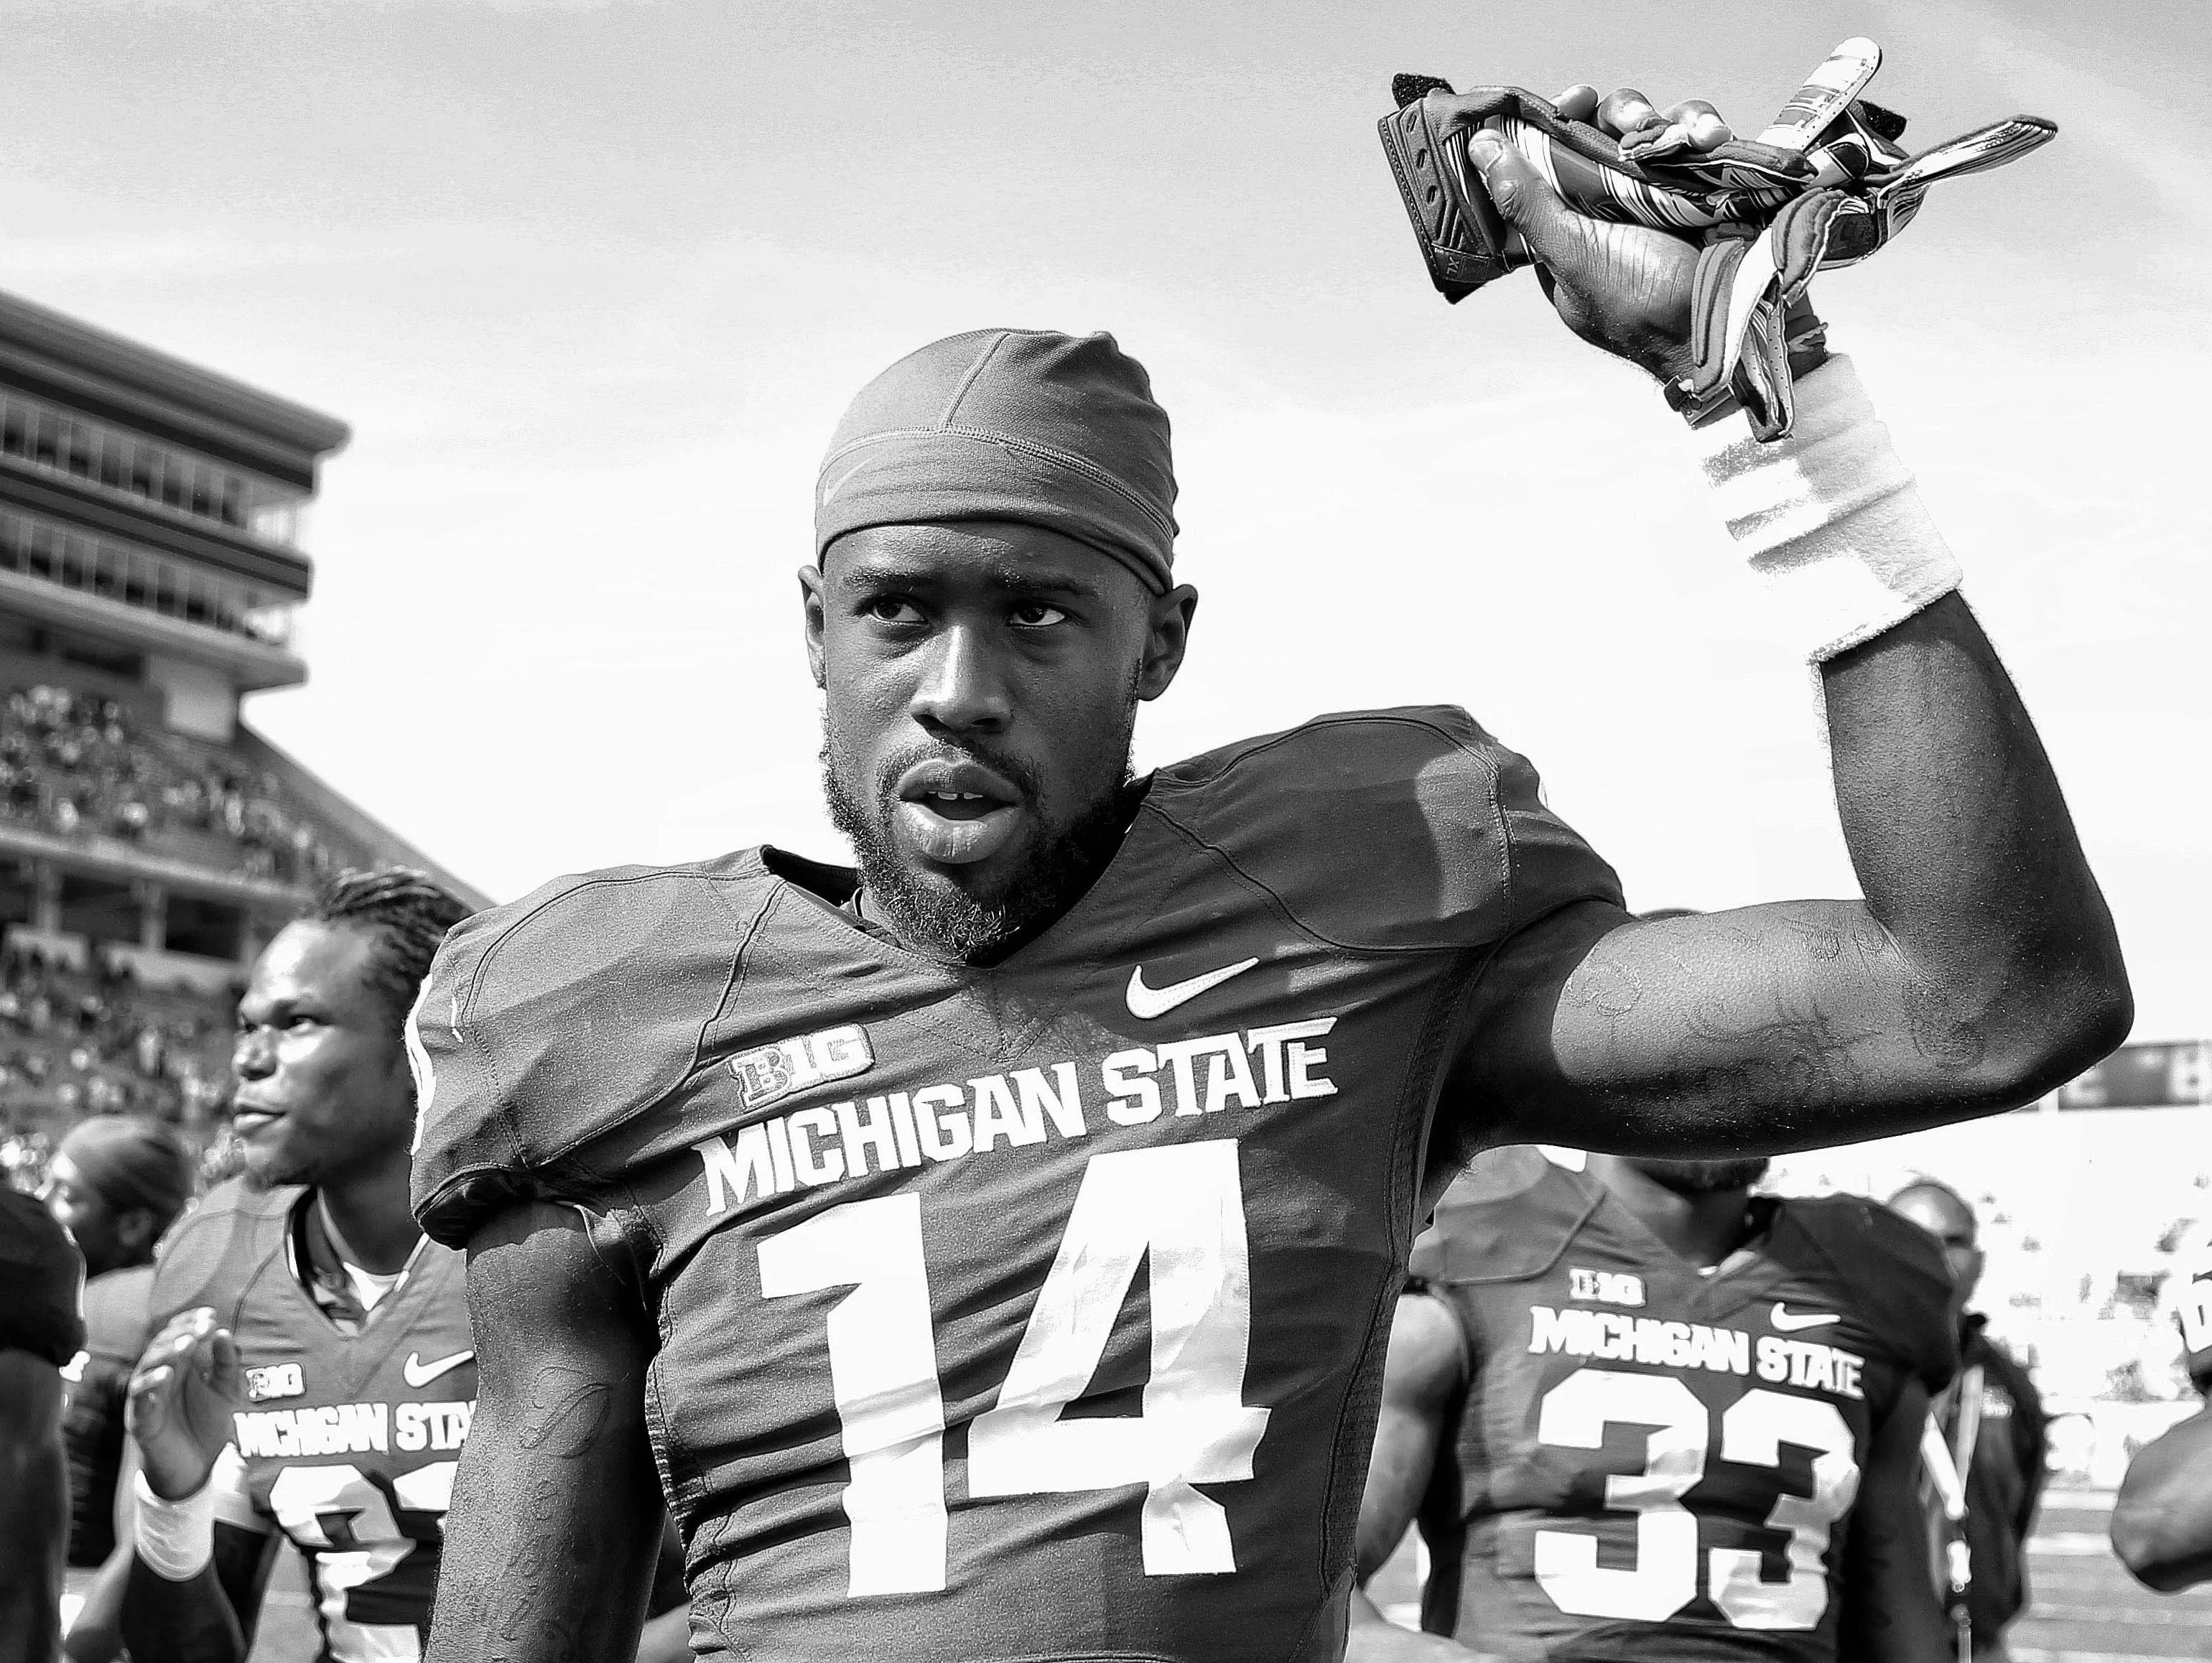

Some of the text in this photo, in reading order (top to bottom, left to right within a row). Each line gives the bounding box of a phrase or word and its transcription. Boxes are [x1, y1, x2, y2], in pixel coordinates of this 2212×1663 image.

[692, 1016, 1339, 1218] MICHIGAN STATE
[233, 1403, 388, 1457] MICHIGAN
[756, 1138, 1272, 1598] 14
[1528, 1305, 1866, 1400] MICHIGAN STATE
[1534, 1368, 1861, 1631] 33
